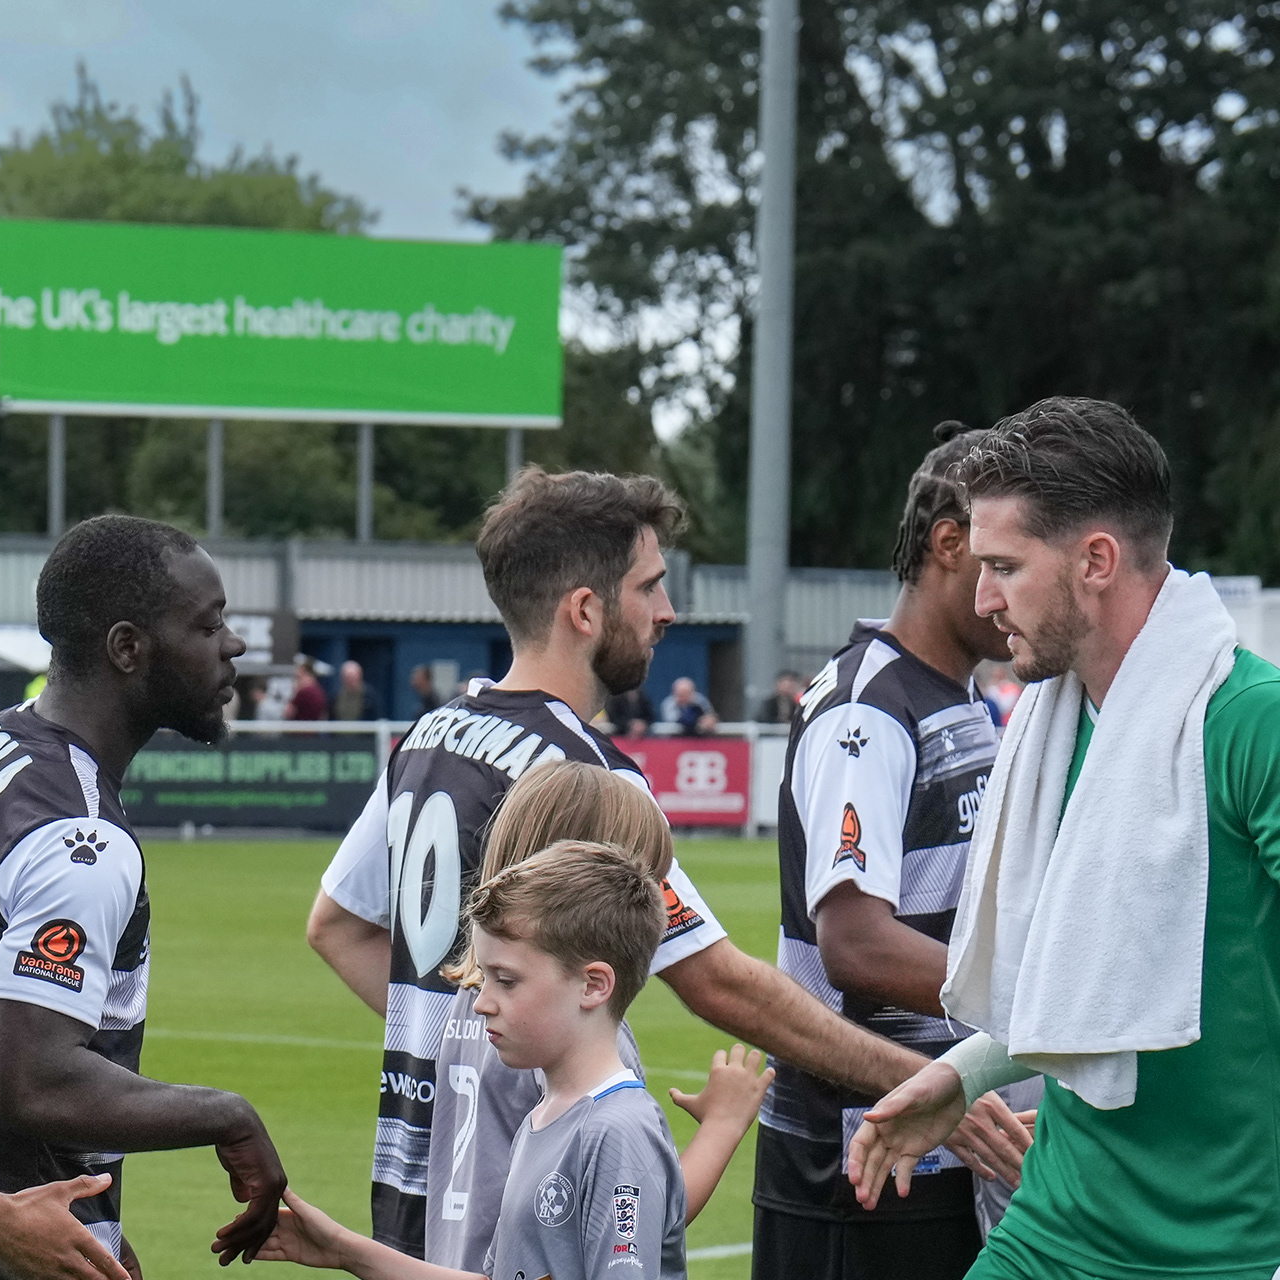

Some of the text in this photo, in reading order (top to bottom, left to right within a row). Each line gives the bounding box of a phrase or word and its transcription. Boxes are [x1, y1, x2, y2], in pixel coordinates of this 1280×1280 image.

[42, 288, 112, 333] UK's
[118, 291, 229, 346] largest
[234, 295, 400, 343] healthcare
[406, 304, 514, 354] charity
[229, 752, 331, 783] SUPPLIES
[334, 753, 376, 783] LTD
[387, 791, 461, 979] 10
[18, 965, 81, 988] NATIONAL LEAGUE
[21, 956, 81, 980] vanarama
